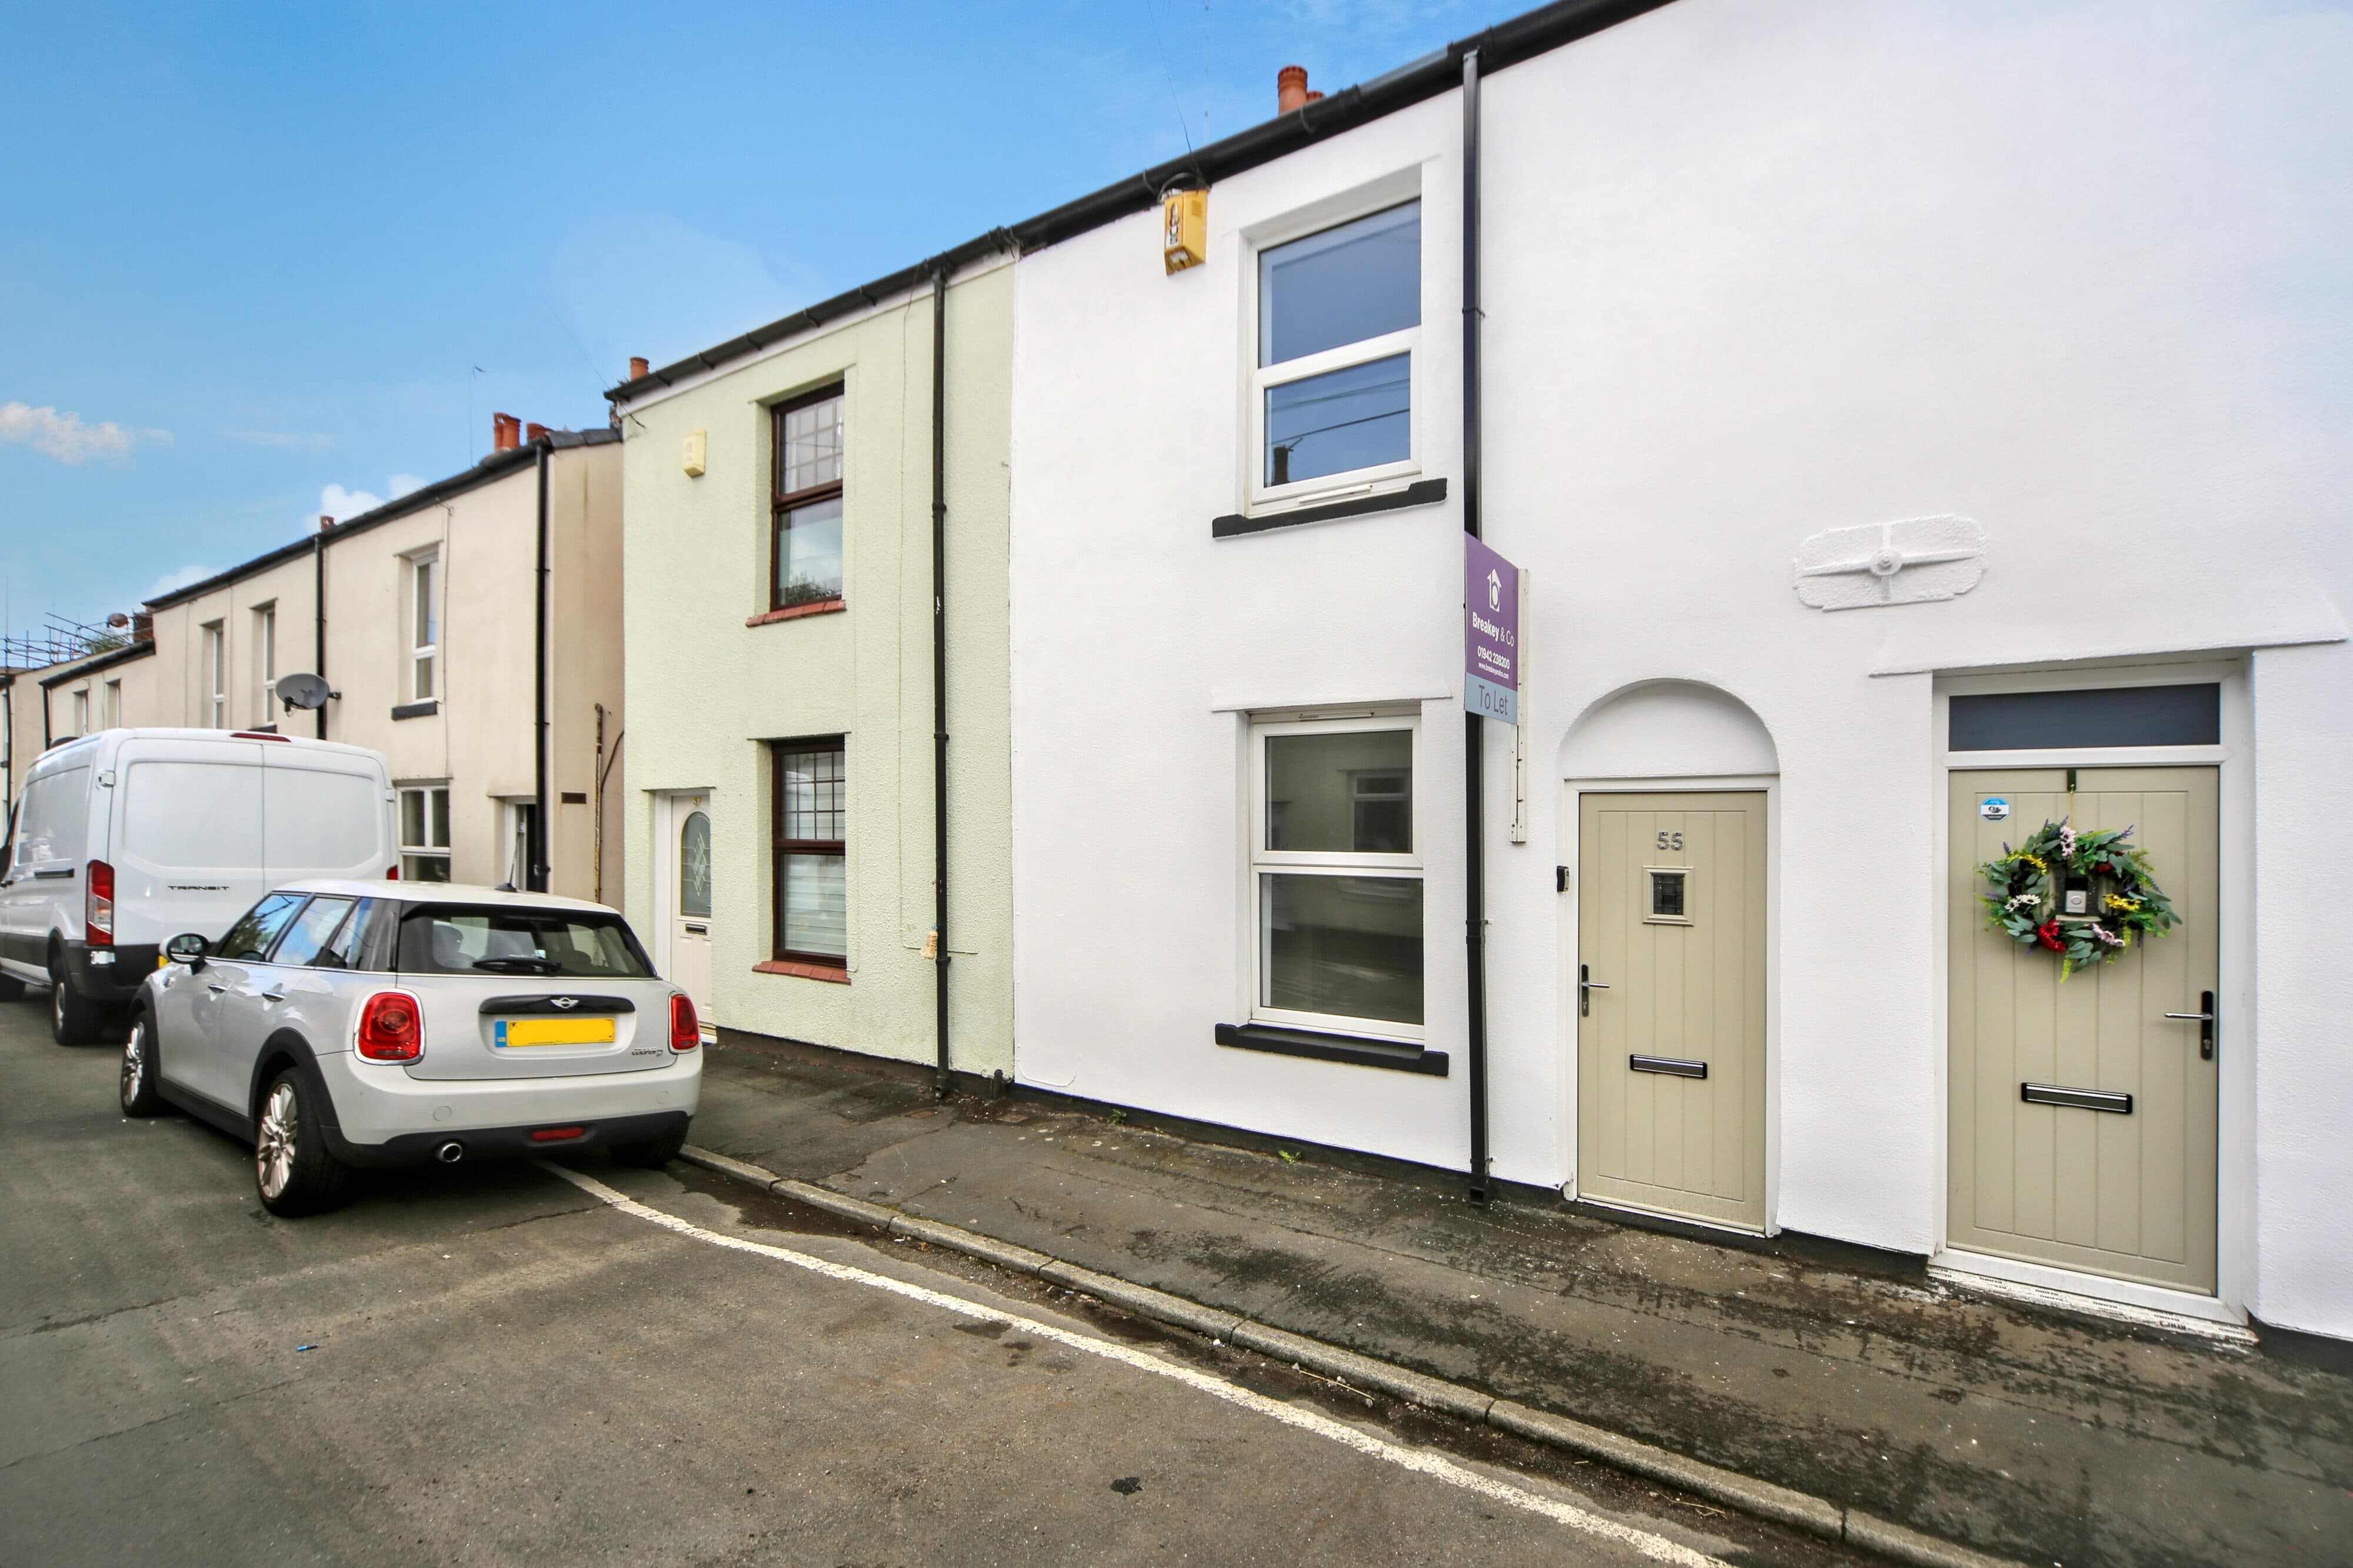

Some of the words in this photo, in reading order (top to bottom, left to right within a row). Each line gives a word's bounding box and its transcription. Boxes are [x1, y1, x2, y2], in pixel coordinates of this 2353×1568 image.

[1472, 611, 1499, 642] Breakey
[1501, 626, 1505, 642] &
[1506, 630, 1514, 647] Co
[1477, 645, 1492, 662] 01942
[1479, 684, 1491, 710] To
[1494, 689, 1508, 716] Let
[1657, 832, 1684, 850] 55
